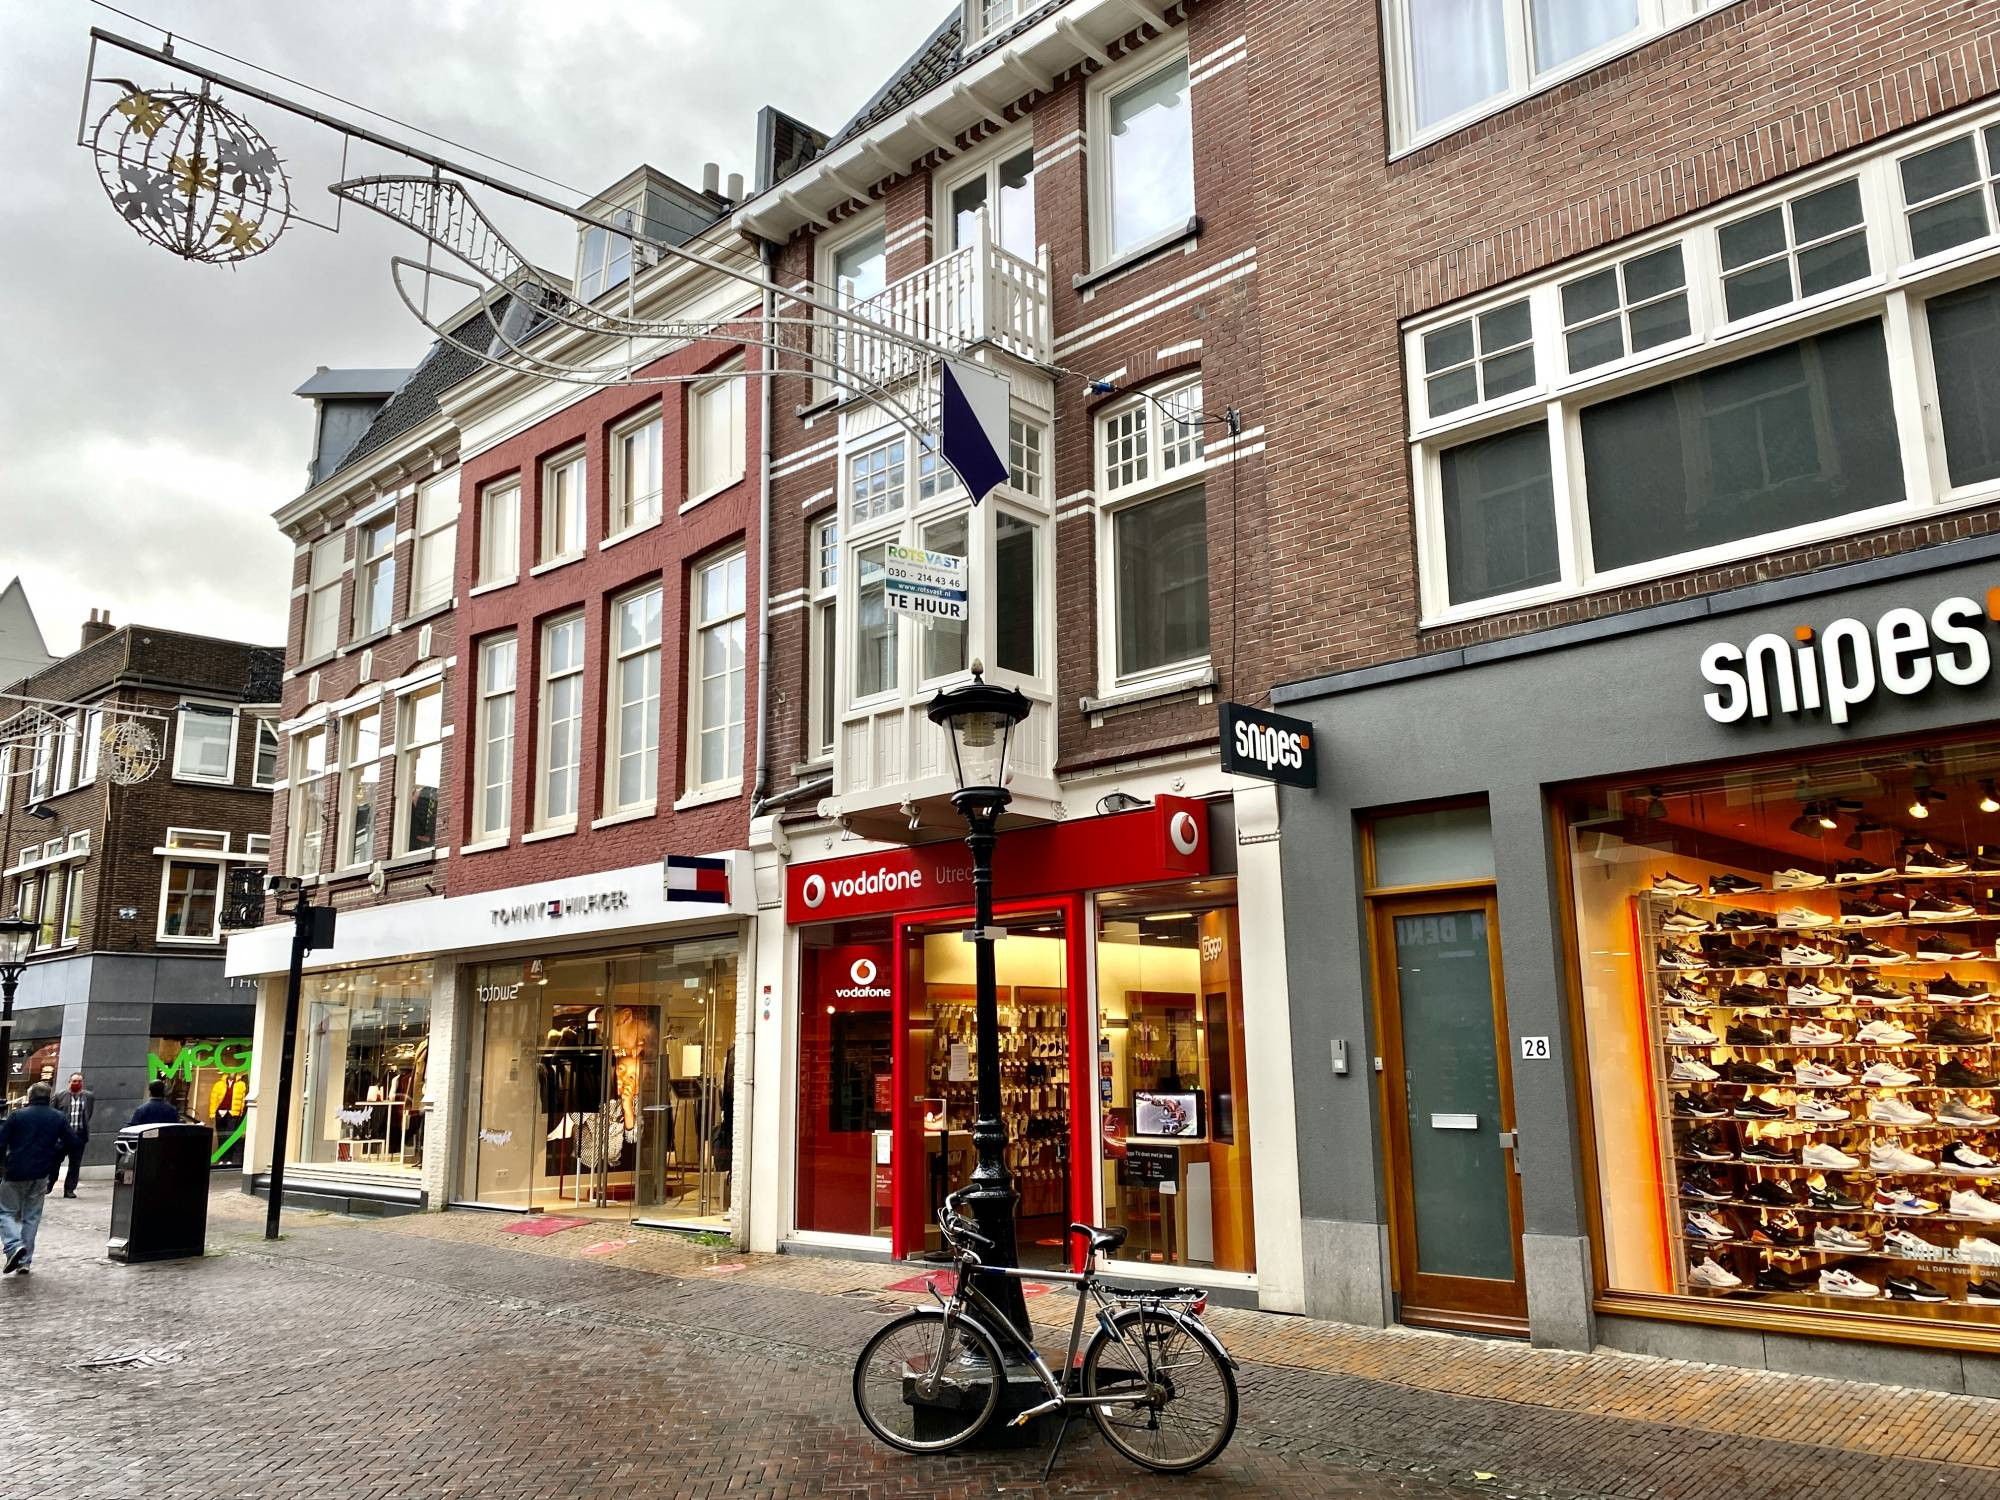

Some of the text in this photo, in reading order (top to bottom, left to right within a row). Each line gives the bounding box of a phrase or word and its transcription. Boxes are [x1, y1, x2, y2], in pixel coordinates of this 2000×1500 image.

[888, 545, 960, 570] ROTSVAST
[888, 567, 907, 578] 030
[917, 572, 932, 583] 214
[935, 576, 946, 586] 43
[949, 579, 960, 588] 46
[898, 582, 951, 598] www.rotsvast.nl
[888, 592, 960, 618] TE HUUR
[1699, 596, 1991, 725] snipes
[1234, 719, 1303, 771] snipes
[831, 866, 973, 898] vodafone Utrec
[489, 889, 629, 926] TOMMY HILFIGER
[835, 986, 891, 998] vodafone
[1524, 1039, 1547, 1057] 28
